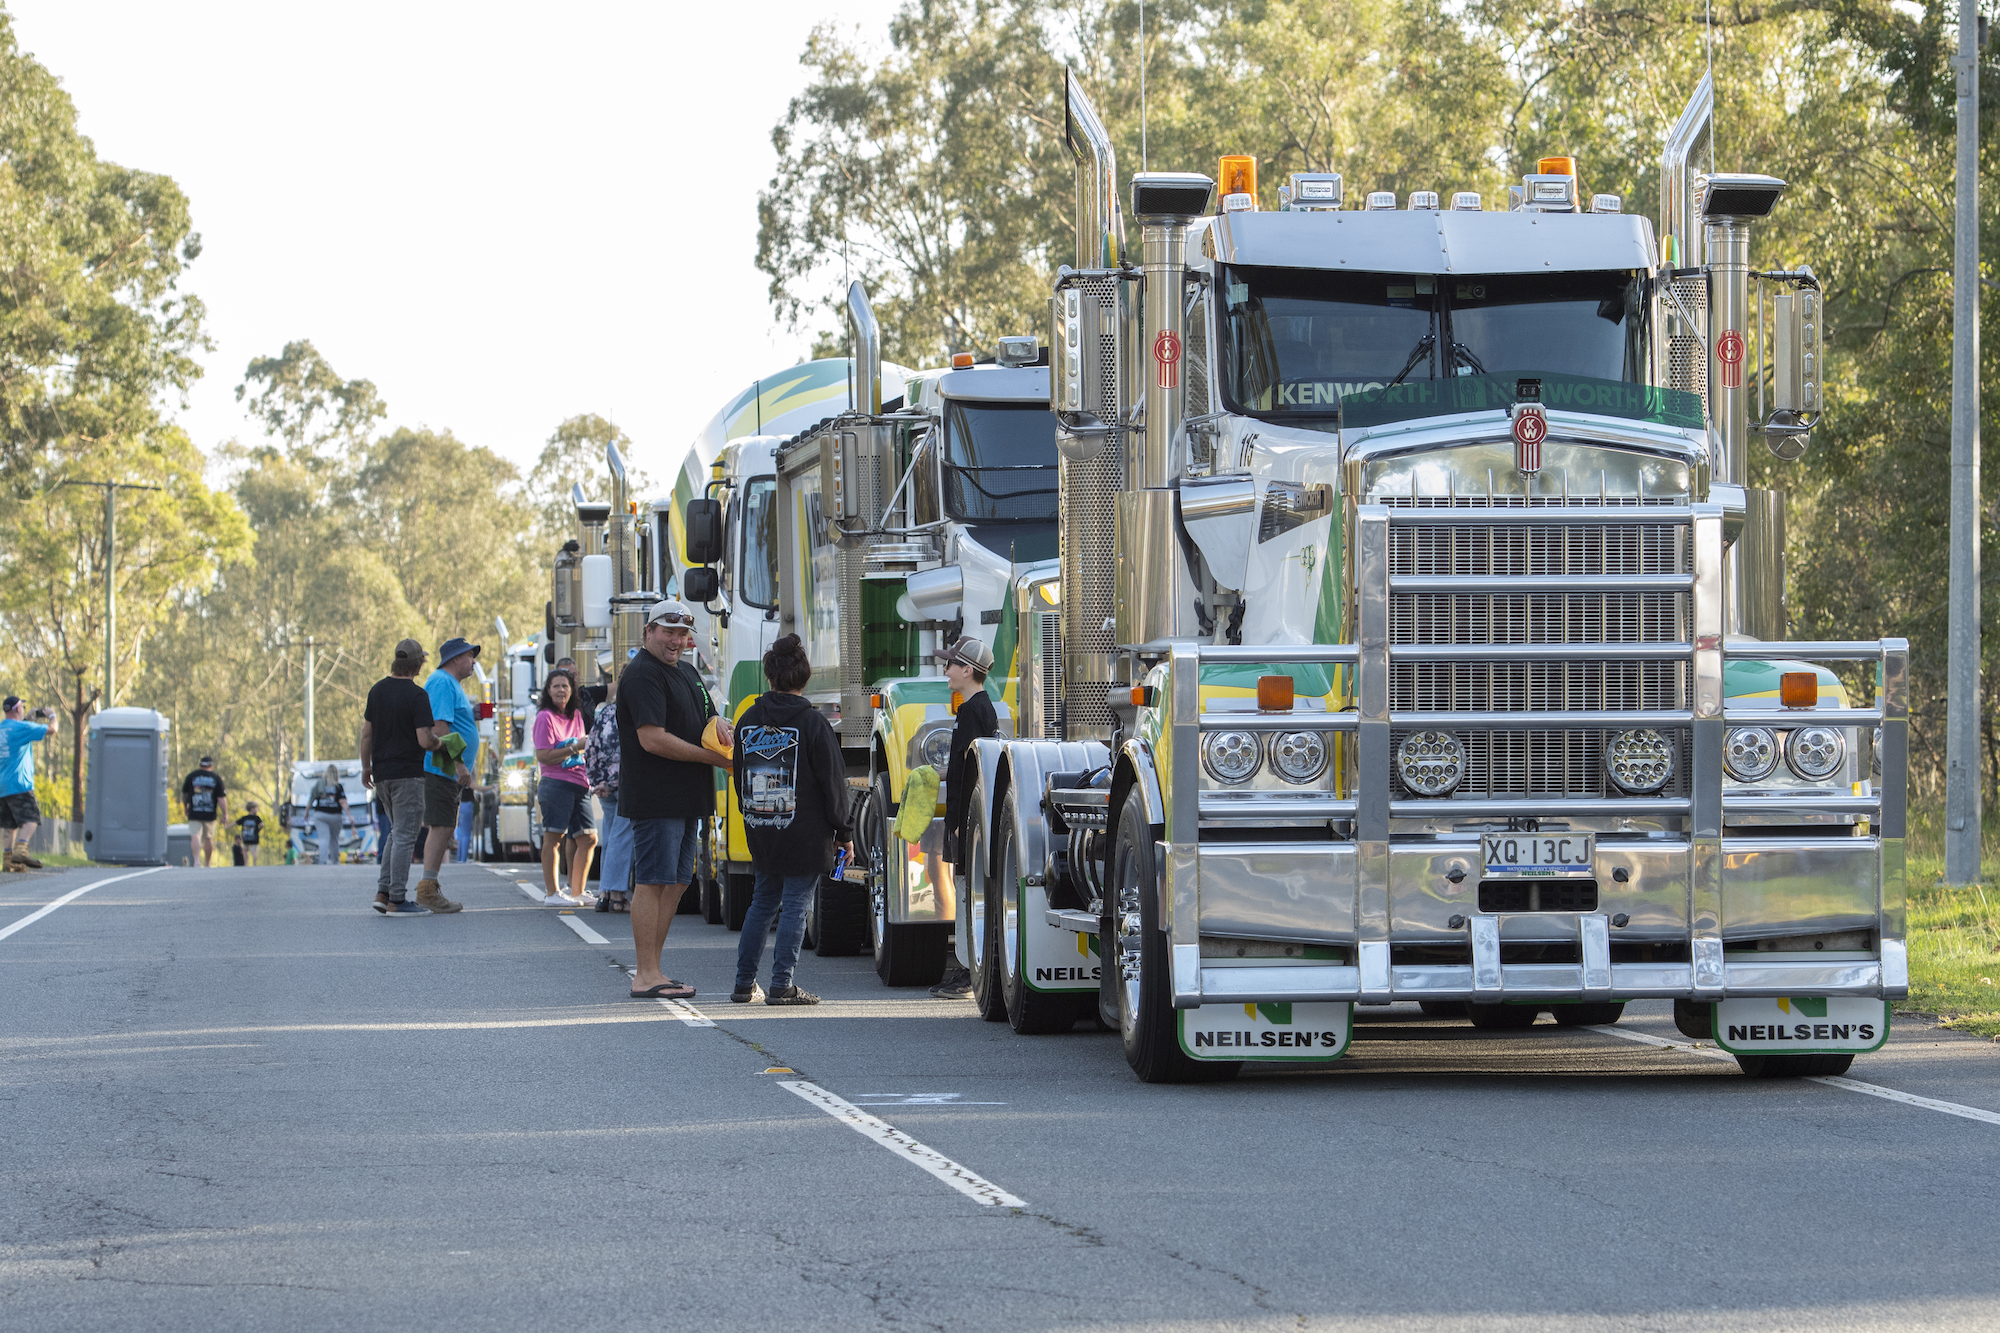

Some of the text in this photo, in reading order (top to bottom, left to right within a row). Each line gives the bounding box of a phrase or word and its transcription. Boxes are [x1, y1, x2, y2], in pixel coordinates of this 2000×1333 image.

[1491, 381, 1638, 409] KWORTH
[1240, 434, 1260, 467] 115
[1195, 1031, 1336, 1047] NEILSEN'S
[1729, 1024, 1875, 1041] NEILSEN'S
